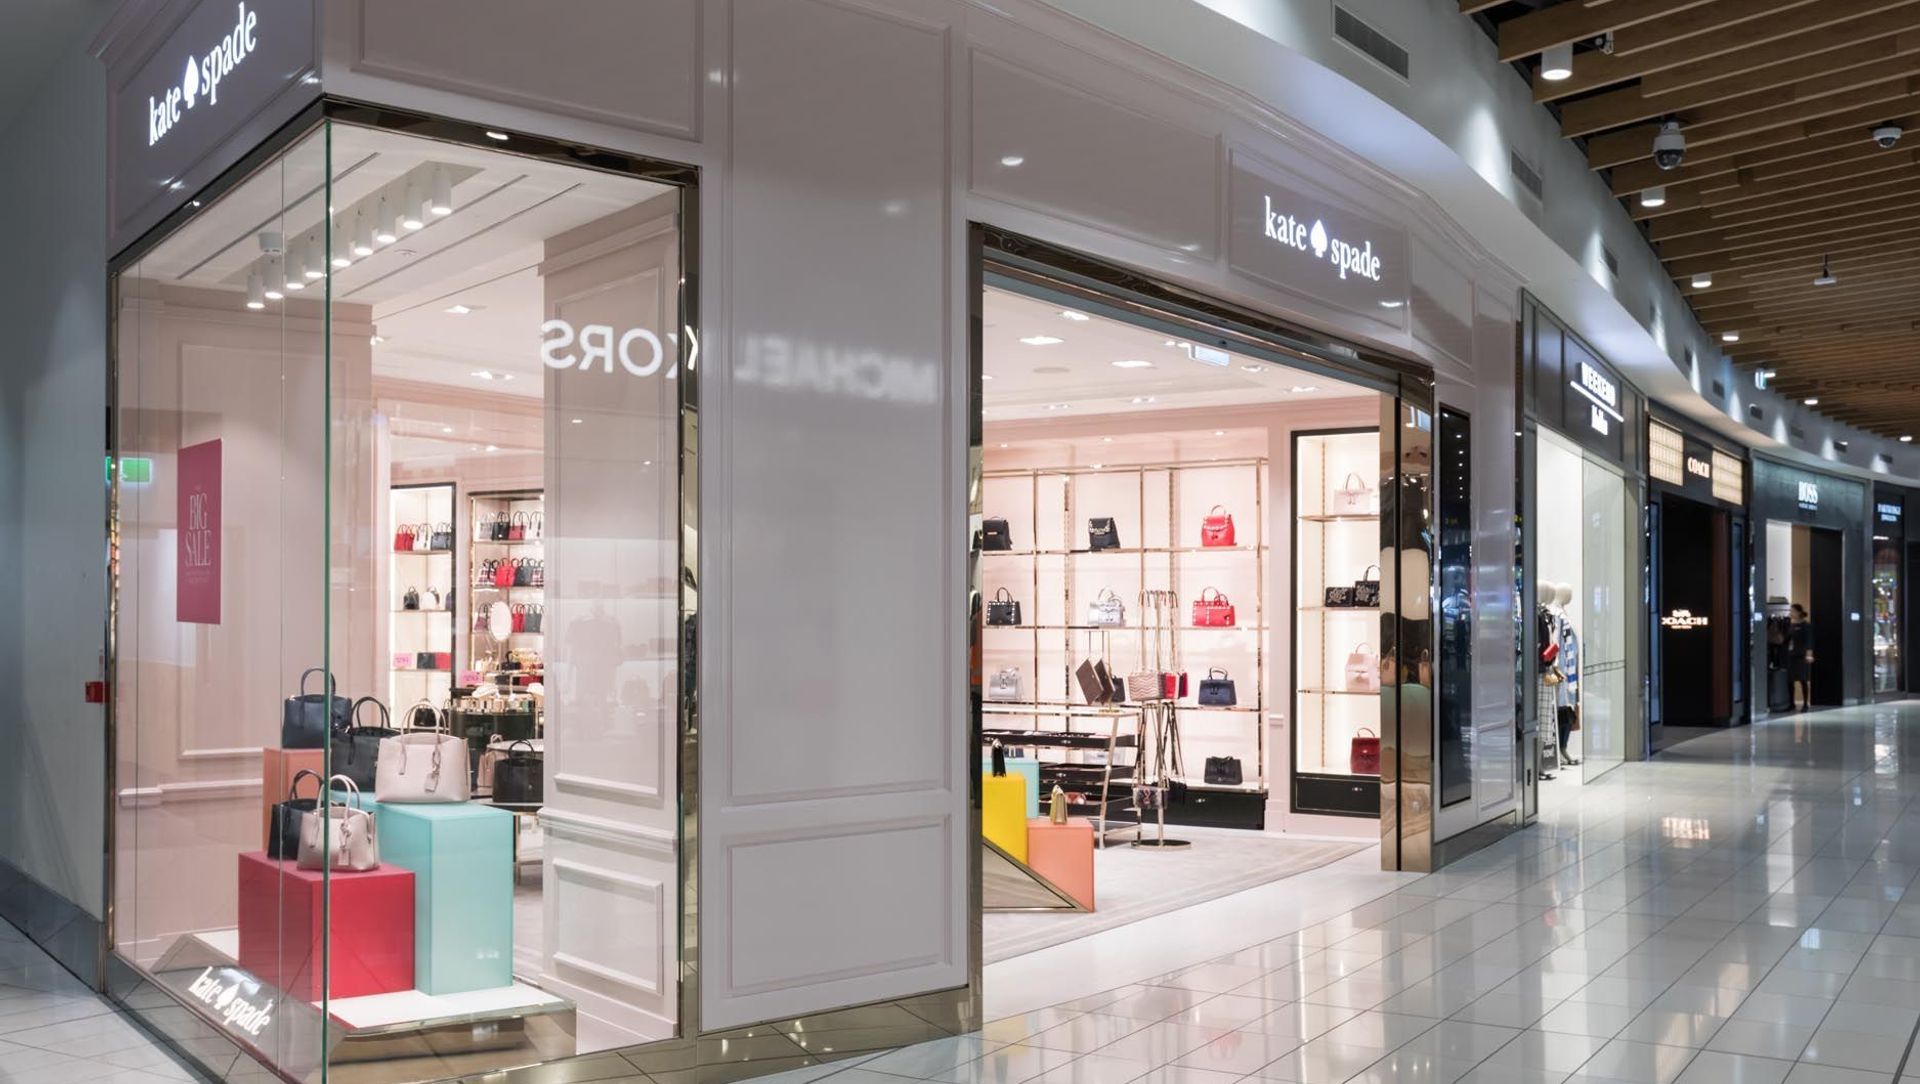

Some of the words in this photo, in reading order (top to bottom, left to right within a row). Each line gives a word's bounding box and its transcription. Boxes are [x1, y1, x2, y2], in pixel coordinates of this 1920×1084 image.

[149, 86, 181, 146] kate
[201, 1, 257, 106] spade
[1265, 194, 1307, 251] kate
[1331, 238, 1380, 281] spade
[1687, 456, 1710, 478] COACH
[189, 492, 208, 530] BIG
[185, 529, 212, 567] SALE
[188, 965, 224, 1003] kate
[223, 997, 273, 1035] spade
